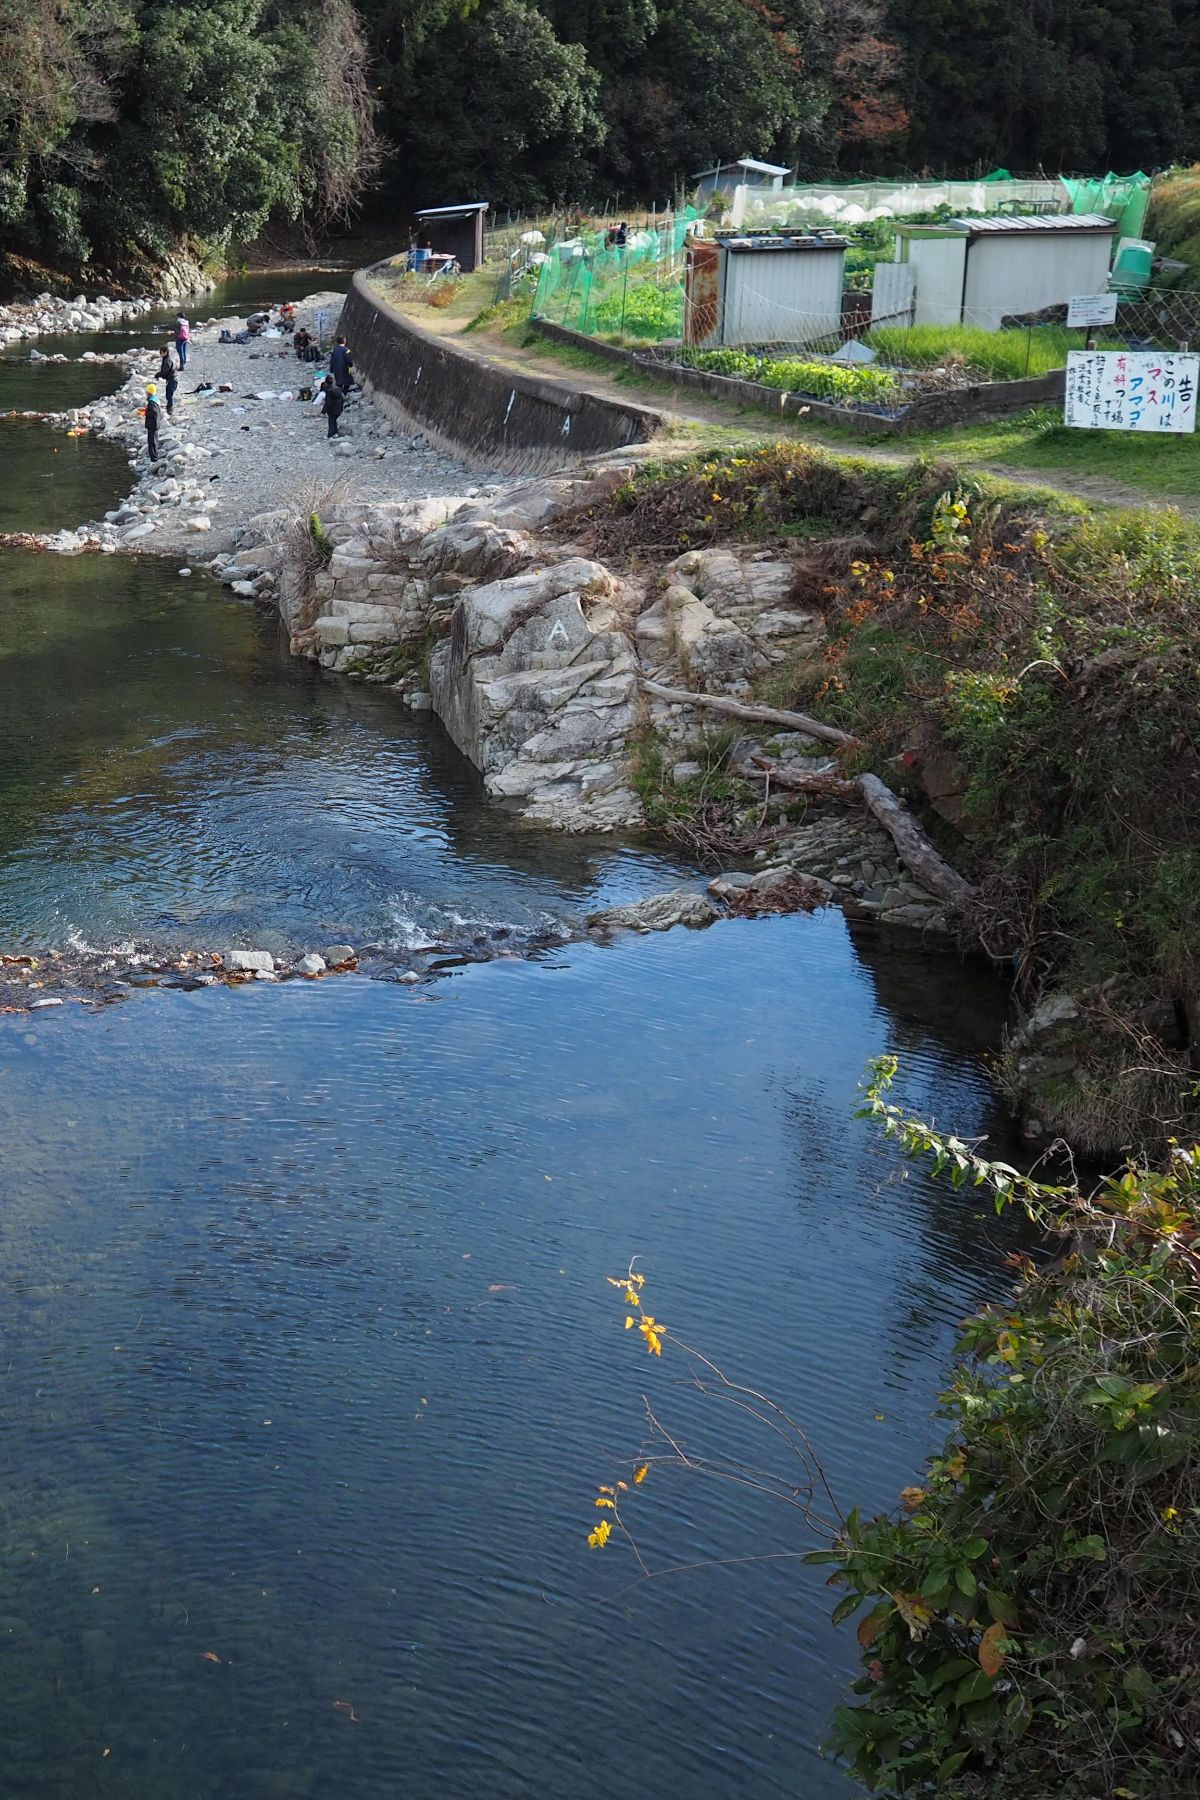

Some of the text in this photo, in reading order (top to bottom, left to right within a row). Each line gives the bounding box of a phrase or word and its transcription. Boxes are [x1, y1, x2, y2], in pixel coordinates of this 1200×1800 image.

[1146, 368, 1162, 405] マス
[1128, 376, 1146, 429] アマゴの
[561, 415, 570, 436] A
[549, 619, 569, 641] A
